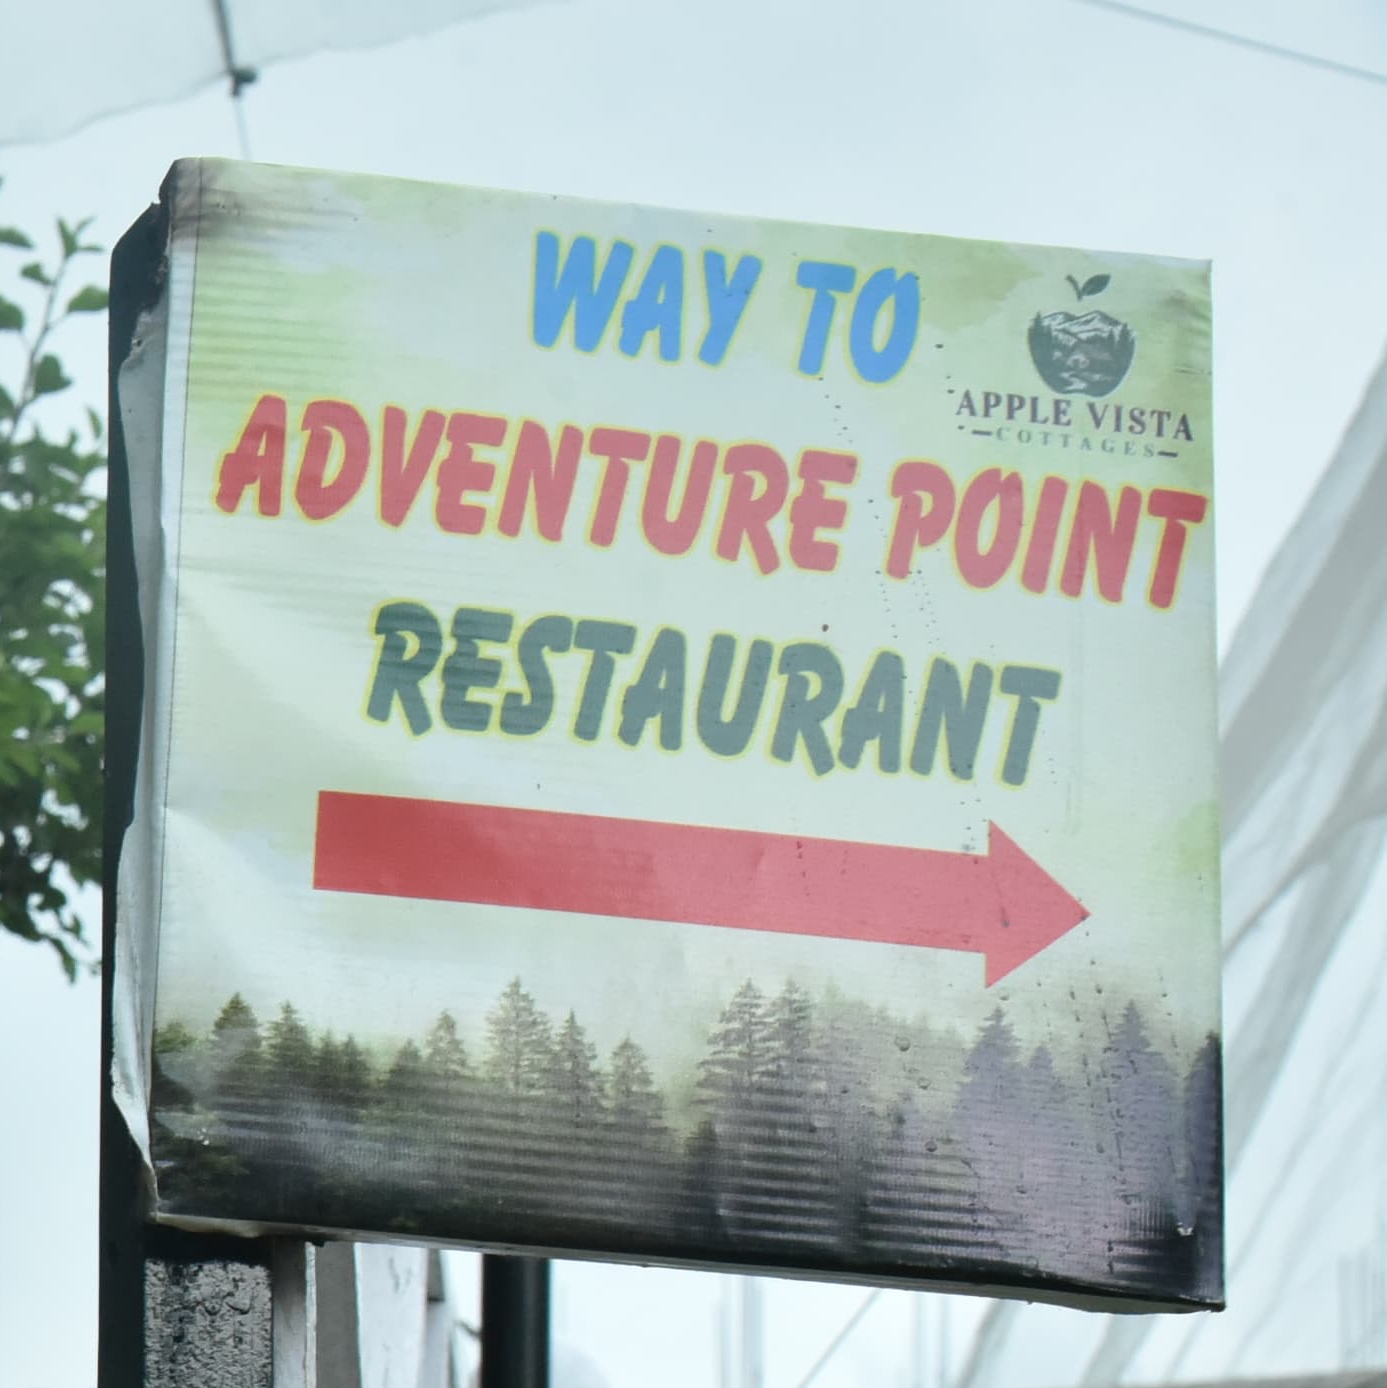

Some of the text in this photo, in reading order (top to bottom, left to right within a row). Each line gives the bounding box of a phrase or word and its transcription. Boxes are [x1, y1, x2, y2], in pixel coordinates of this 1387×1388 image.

[532, 230, 920, 383] WAY TO
[956, 389, 1195, 442] APPLE VISTA
[216, 395, 1207, 608] ADVENTURE POINT
[363, 601, 1061, 788] RESTAURANT
